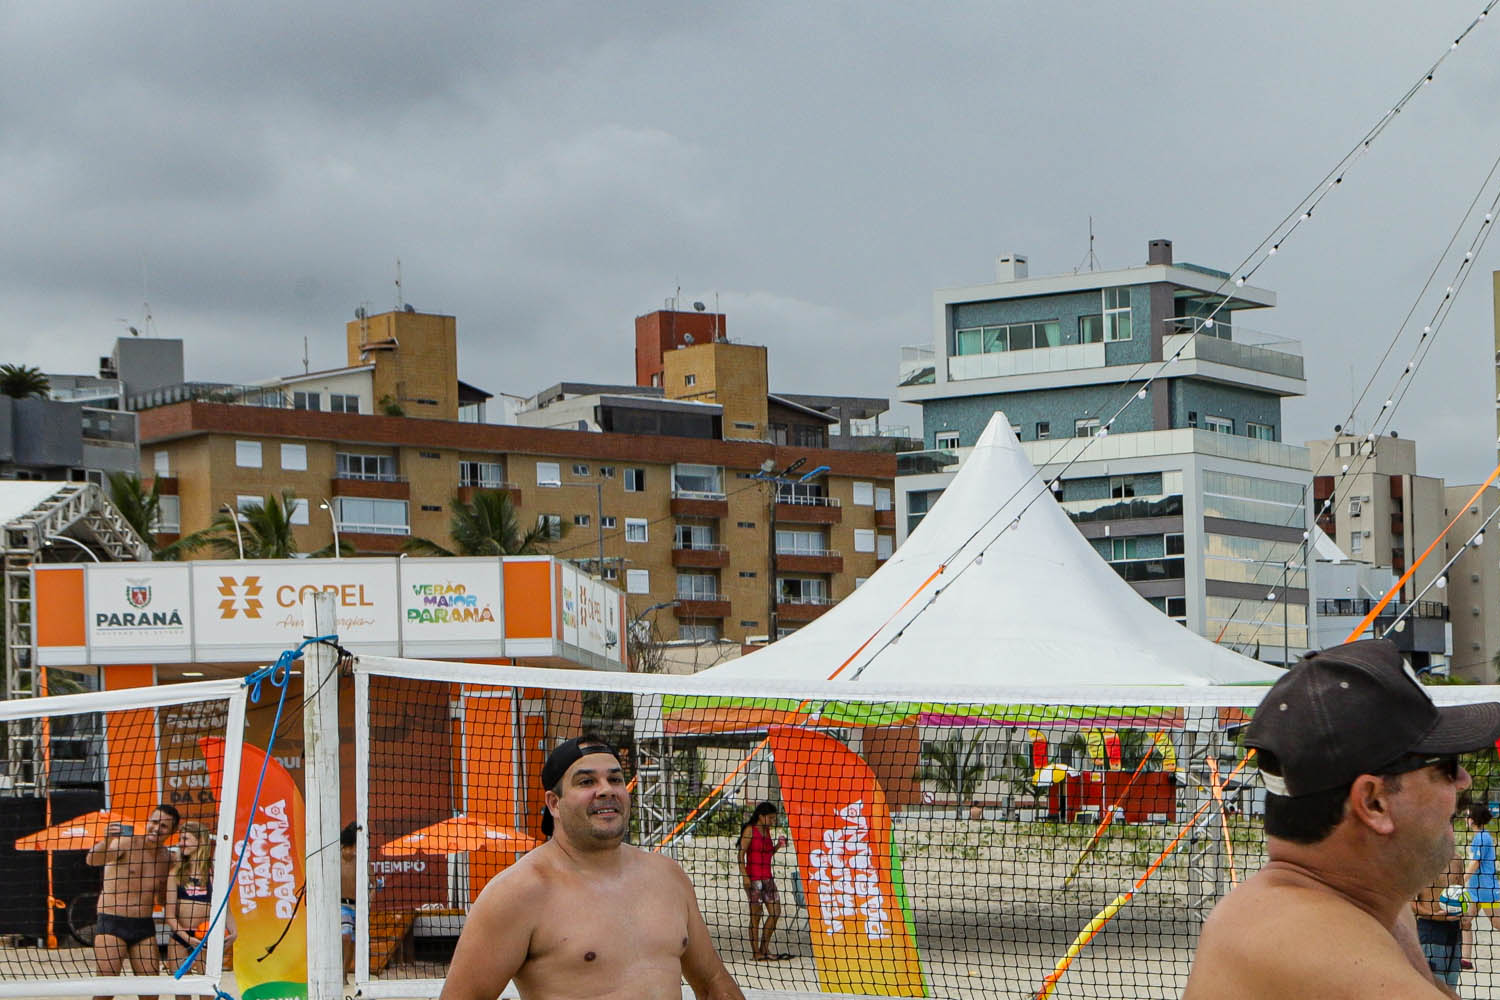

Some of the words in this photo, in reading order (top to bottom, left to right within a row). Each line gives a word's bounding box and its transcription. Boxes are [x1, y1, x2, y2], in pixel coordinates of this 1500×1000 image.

[95, 608, 184, 627] PARANÁ
[407, 603, 495, 624] PARANÁ
[423, 594, 477, 607] MAIOR
[249, 823, 273, 898] MAIOR
[259, 799, 298, 919] PARANÁ
[823, 828, 856, 916] MAIOR
[833, 799, 892, 940] PARANÁ
